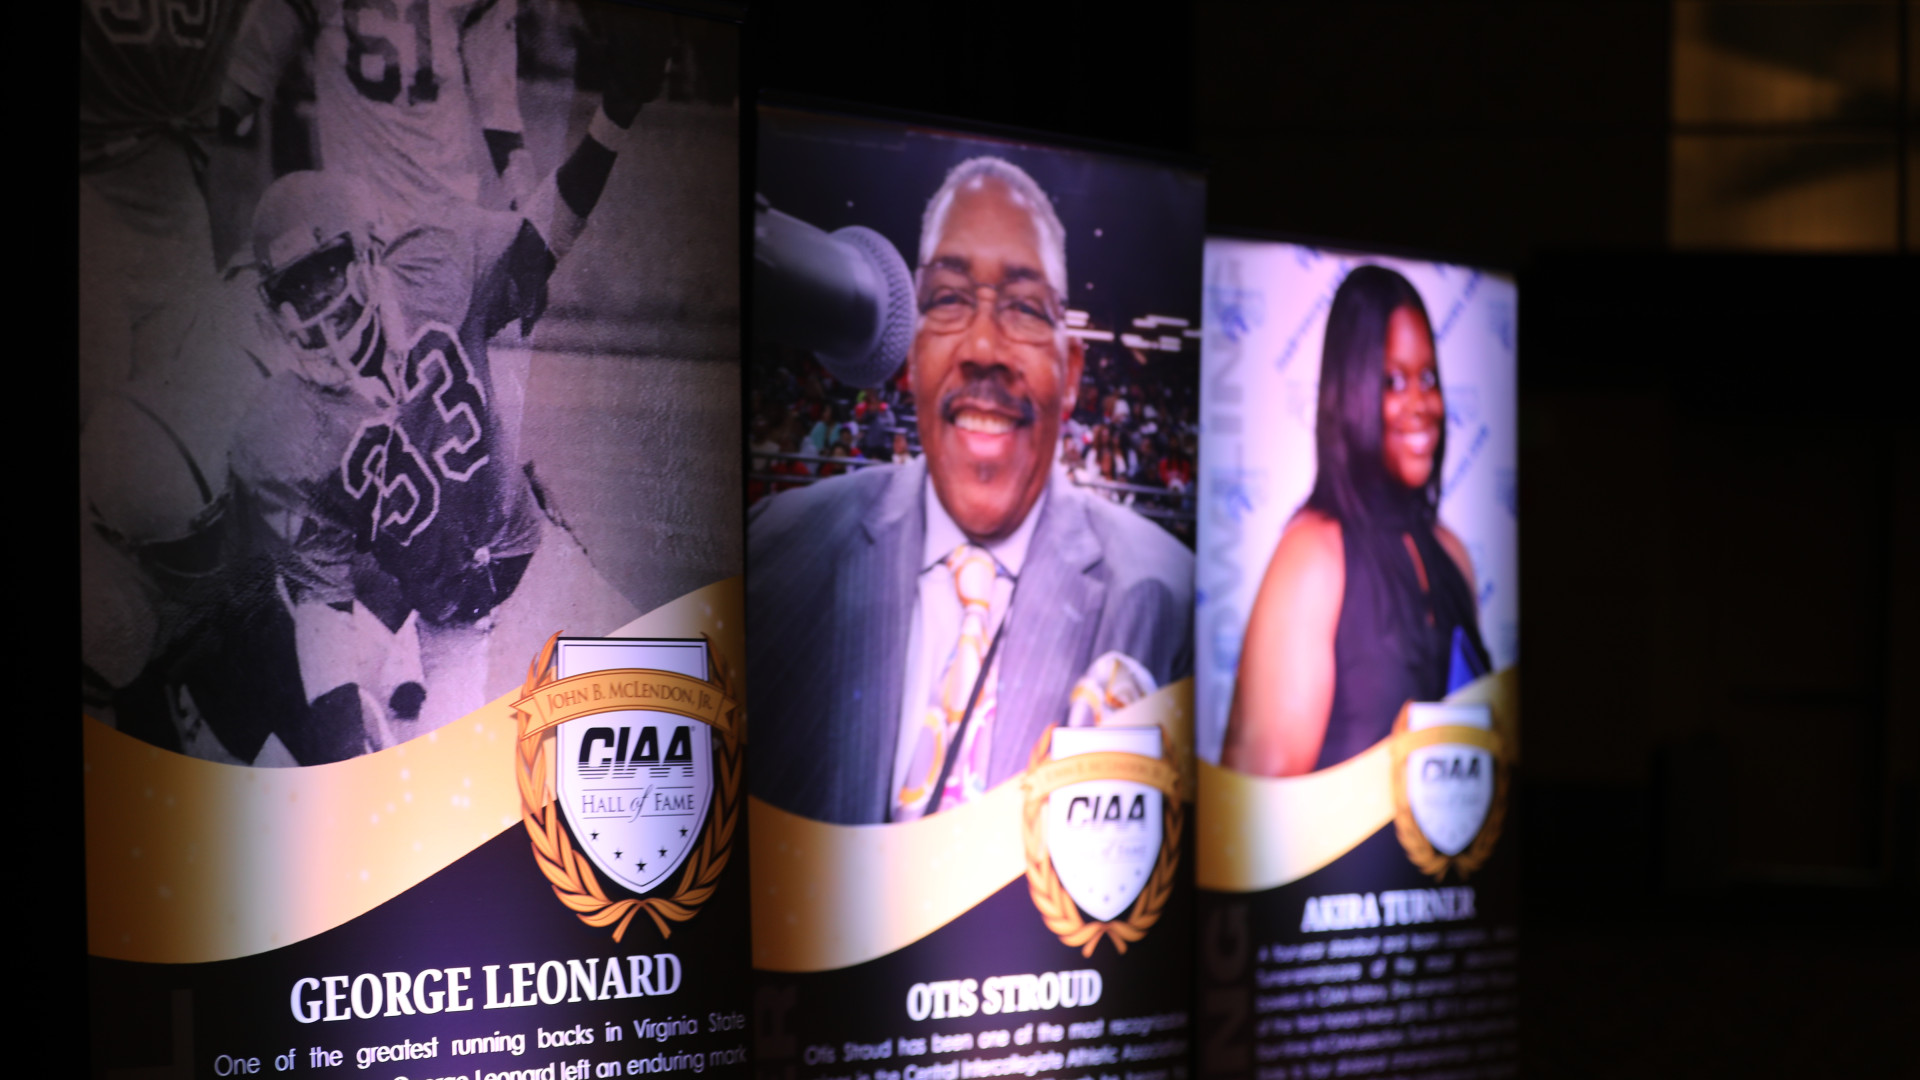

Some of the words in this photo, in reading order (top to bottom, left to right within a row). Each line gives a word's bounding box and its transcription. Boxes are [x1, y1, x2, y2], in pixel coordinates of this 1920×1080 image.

[546, 686, 588, 716] JOHN
[578, 725, 694, 779] CIAA
[582, 795, 625, 814] HALL
[629, 784, 654, 823] of
[655, 793, 695, 812] FAME
[290, 965, 474, 1024] GEORGE
[482, 952, 683, 1010] LEONARD
[906, 979, 979, 1021] OTIS
[981, 969, 1103, 1016] STROUD
[213, 1053, 261, 1077] One
[274, 1048, 296, 1072] of
[309, 1046, 344, 1069] the
[356, 1036, 439, 1070] greatest
[451, 1030, 525, 1056] running
[537, 1024, 594, 1049] backs
[605, 1021, 623, 1043] in
[633, 1015, 698, 1043] Virginia
[708, 1011, 746, 1033] State
[560, 1059, 591, 1080] left
[596, 1060, 622, 1079] an
[626, 1050, 705, 1075] enduring
[709, 1045, 748, 1067] mark
[843, 1036, 893, 1062] Stroud
[897, 1035, 928, 1057] has
